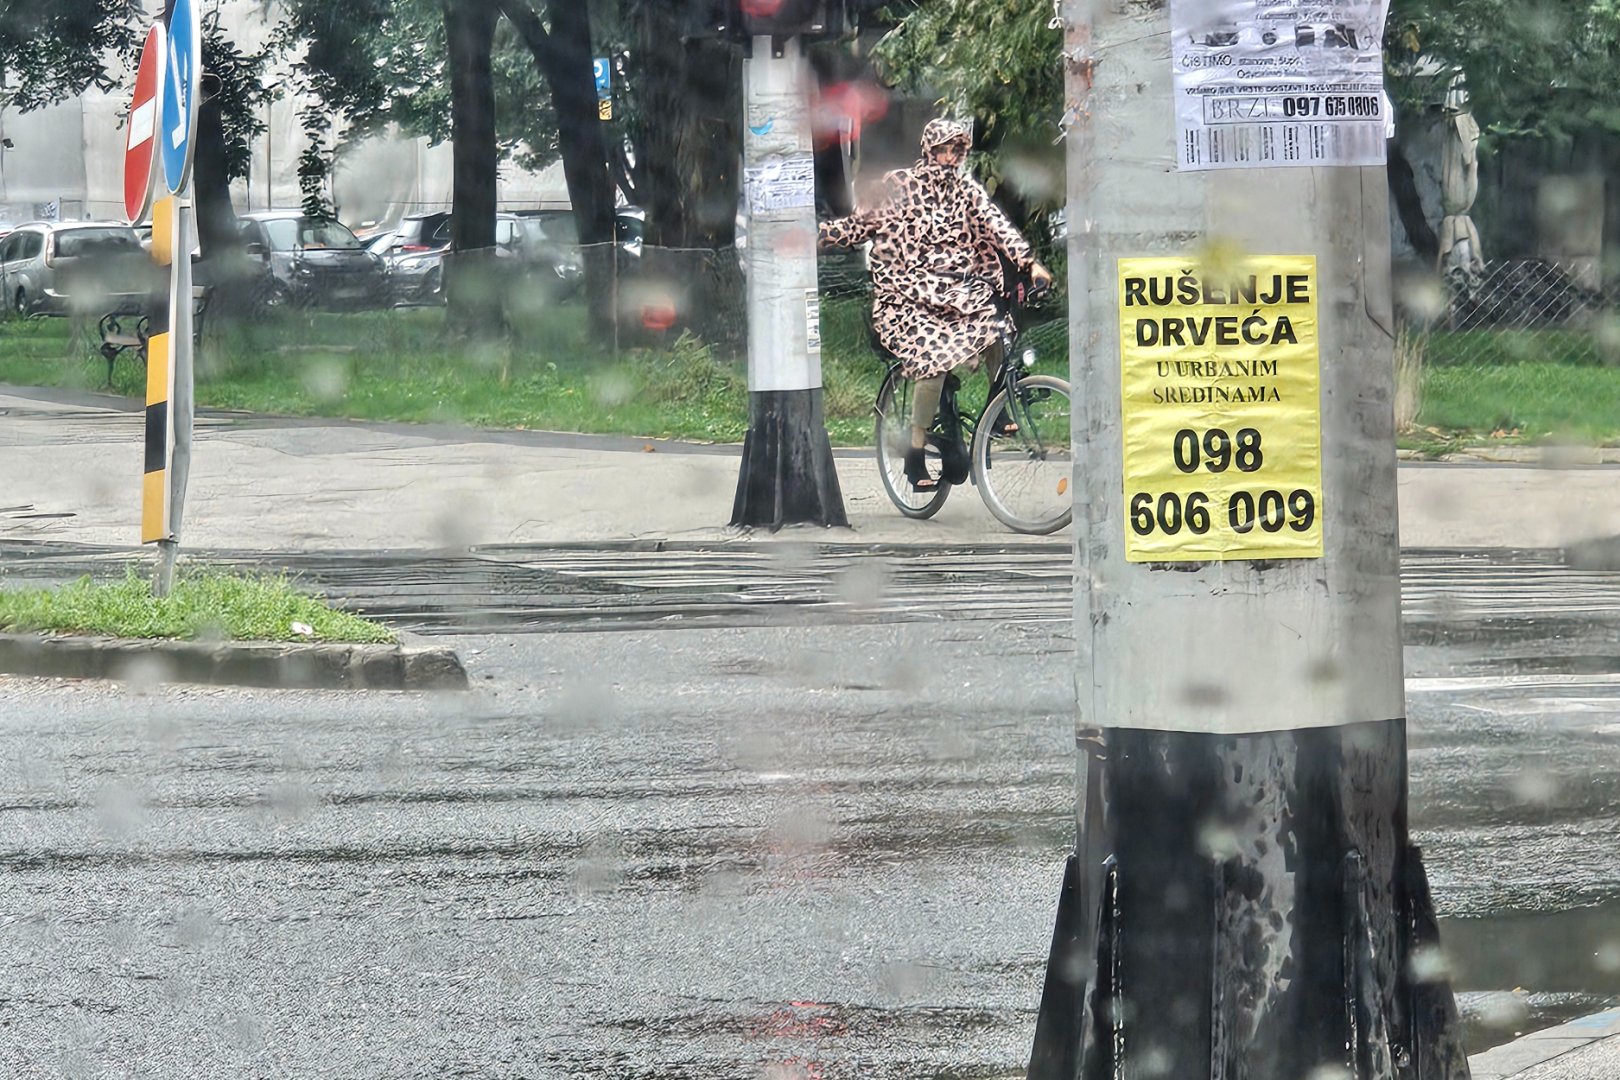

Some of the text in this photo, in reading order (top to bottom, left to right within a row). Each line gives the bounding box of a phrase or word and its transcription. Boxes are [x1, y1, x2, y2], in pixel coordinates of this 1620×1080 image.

[1282, 96, 1320, 117] 097
[1325, 96, 1346, 116] 675
[1347, 96, 1379, 116] 0806
[1125, 269, 1311, 307] RUŠENJE
[1135, 309, 1299, 348] DRVEĆA
[1157, 359, 1278, 378] U URBANIM
[1153, 386, 1281, 404] SREDINAMA
[1173, 428, 1264, 473] 098
[1130, 489, 1315, 536] 606 009
